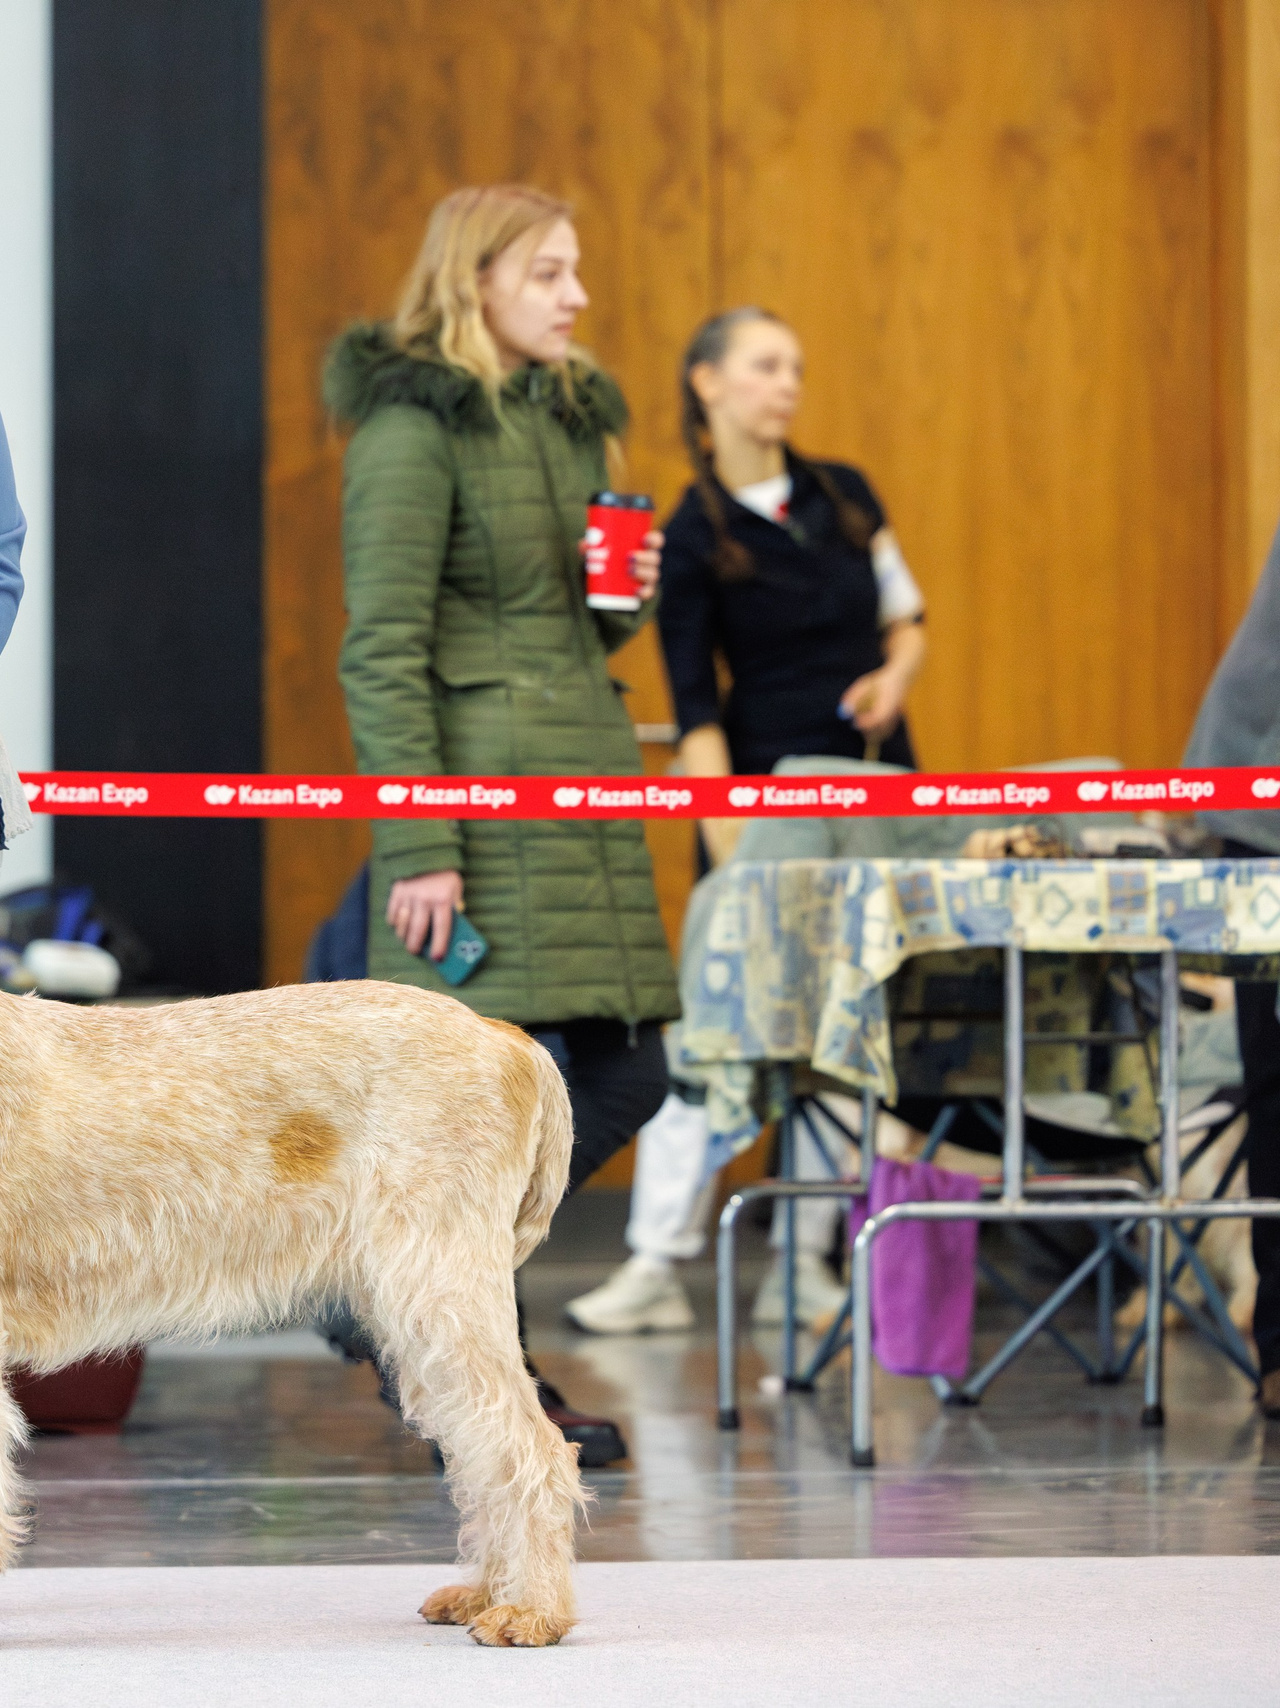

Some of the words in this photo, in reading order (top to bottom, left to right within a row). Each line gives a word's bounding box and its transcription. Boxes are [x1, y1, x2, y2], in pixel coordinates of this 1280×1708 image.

[43, 782, 100, 803] Kazan
[101, 782, 149, 807] Expo
[238, 785, 295, 804] Kazan
[296, 784, 343, 808] Expo
[411, 785, 468, 805] Kazan
[469, 784, 517, 809] Expo
[587, 787, 644, 807] Kazan
[645, 786, 693, 810] Expo
[762, 785, 819, 805] Kazan
[820, 784, 868, 809] Expo
[945, 785, 1002, 805] Kazan
[1003, 783, 1050, 807] Expo
[1111, 780, 1167, 800] Kazan
[1169, 778, 1215, 802] Expo
